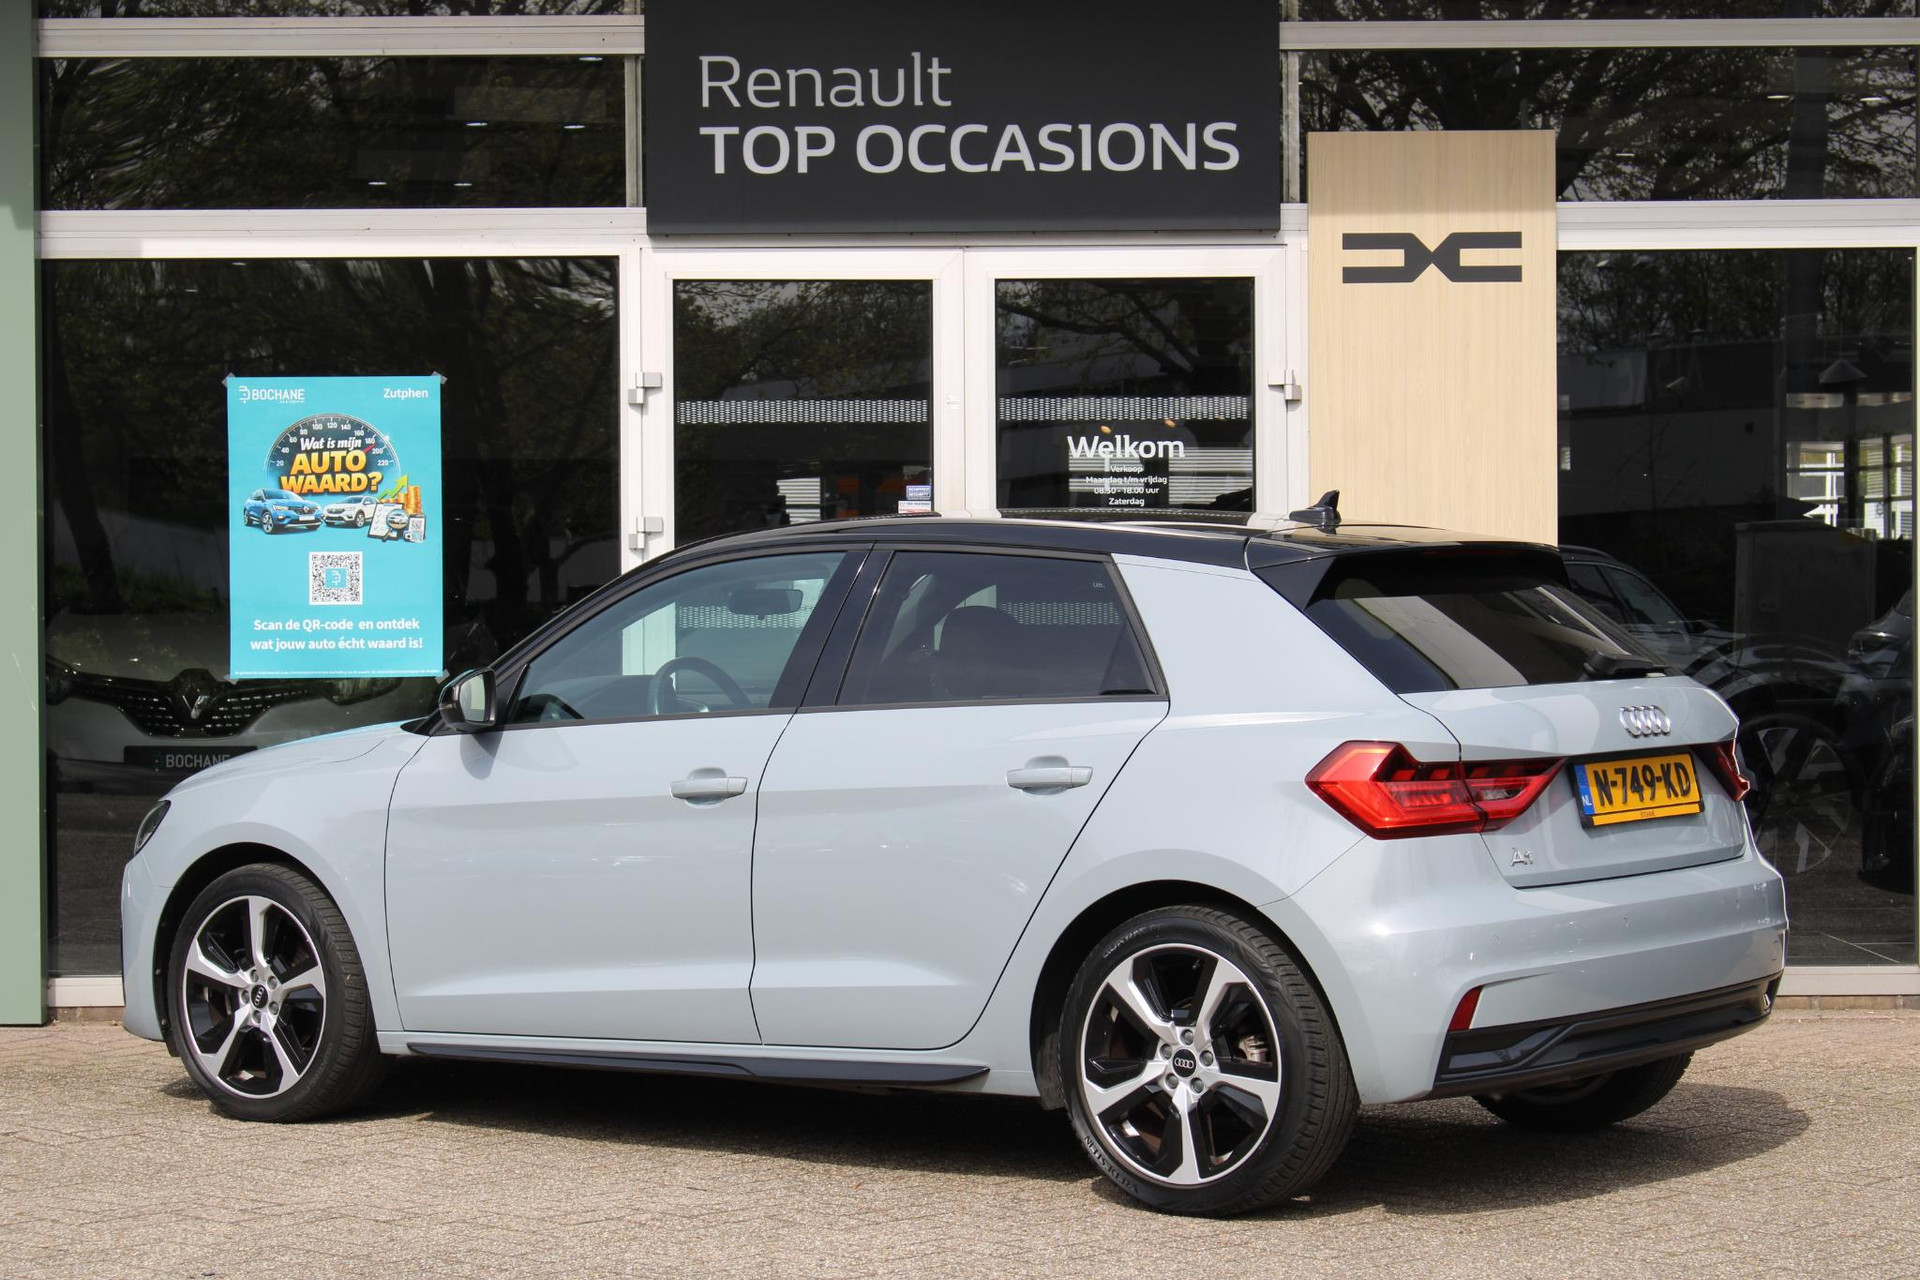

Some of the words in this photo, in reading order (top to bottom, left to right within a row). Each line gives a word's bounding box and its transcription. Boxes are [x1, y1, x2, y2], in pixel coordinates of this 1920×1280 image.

[699, 52, 952, 108] Renault
[699, 125, 836, 175] TOP
[855, 121, 1240, 173] OCCASIONS
[251, 388, 305, 400] BOCHANE
[383, 388, 429, 401] Zutphen
[300, 437, 324, 451] Wat
[327, 437, 336, 449] is
[337, 437, 361, 451] mijn
[1067, 434, 1185, 458] Welkom
[290, 450, 367, 475] AUTO
[1110, 465, 1143, 474] Verkoop
[281, 471, 383, 493] WAARD?
[1086, 475, 1122, 485] Maandag
[1124, 475, 1139, 485] t/m
[1140, 475, 1168, 485] vrijdag
[1108, 497, 1145, 507] Zaterdag
[253, 619, 283, 631] Scan
[285, 619, 300, 630] de
[302, 618, 354, 632] QR-code
[358, 621, 374, 630] en
[376, 618, 420, 630] ontdek
[250, 639, 274, 650] wat
[275, 639, 305, 652] jouw
[308, 639, 336, 650] auto
[338, 637, 365, 649] écht
[367, 637, 406, 649] waard
[408, 637, 423, 649] is!
[1592, 762, 1691, 807] N-749-KD
[1581, 795, 1592, 806] NL
[1510, 848, 1534, 867] A1
